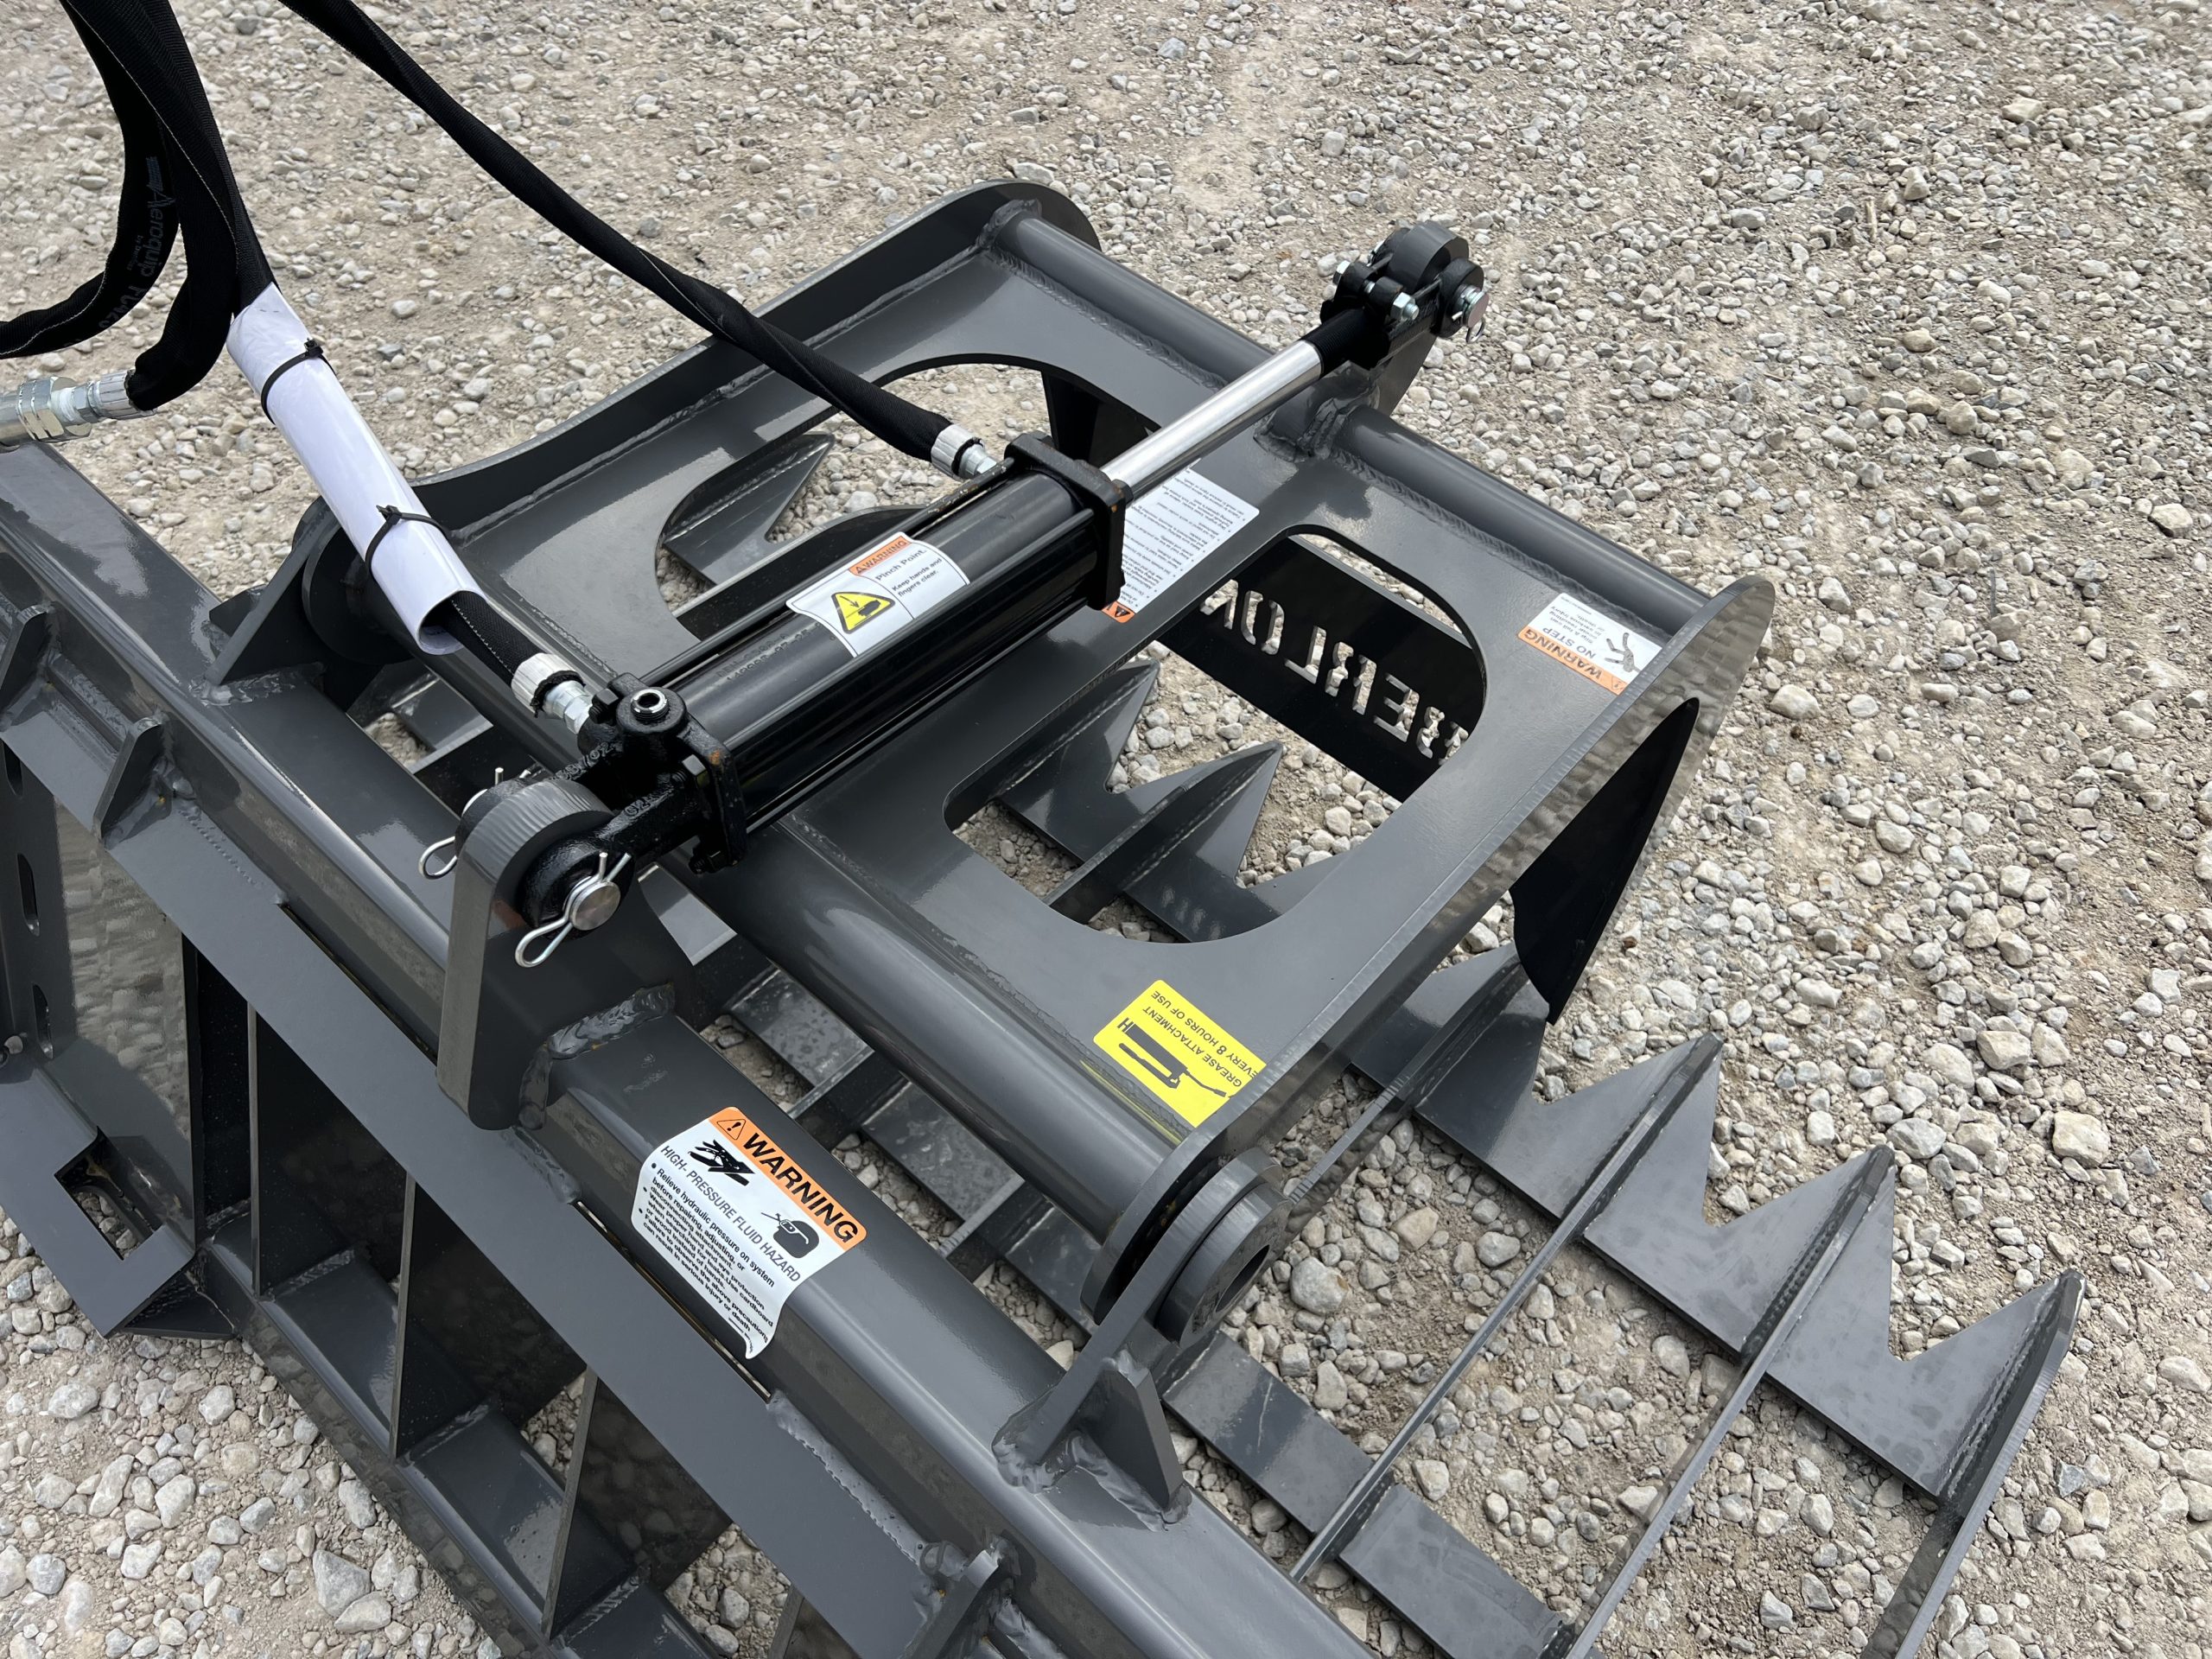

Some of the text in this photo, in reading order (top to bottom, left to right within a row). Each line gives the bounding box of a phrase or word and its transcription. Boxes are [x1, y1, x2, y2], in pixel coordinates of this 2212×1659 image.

[141, 189, 175, 277] Aeroquip
[864, 541, 908, 569] WARNING
[874, 563, 902, 582] Pinch
[891, 557, 942, 591] Keep hands and
[897, 579, 922, 597] fingers
[1525, 629, 1602, 679] WARNING
[1542, 627, 1597, 659] NO STEP
[1141, 1004, 1243, 1088] GREASE ATTACHMENT
[1151, 990, 1258, 1078] EVERY 8 HOURS OF USE
[649, 1185, 696, 1231] disconnecting
[651, 1177, 674, 1200] before
[671, 1198, 705, 1232] repairing,
[736, 1262, 746, 1272] or
[656, 1167, 776, 1287] Relieve hydraulic pressure on system
[660, 1146, 801, 1283] HIGH- PRESSURE FLUID HAZARD
[743, 1133, 859, 1243] WARNING
[642, 1222, 655, 1235] can
[654, 1234, 674, 1253] result
[673, 1252, 681, 1261] in
[679, 1259, 705, 1285] serious
[702, 1282, 724, 1305] injury
[722, 1302, 731, 1312] or
[643, 1213, 667, 1237] Failure
[665, 1236, 674, 1245] to
[673, 1243, 700, 1271] observe
[699, 1269, 710, 1281] the
[710, 1281, 733, 1303] above
[645, 1207, 653, 1217] or
[652, 1215, 672, 1235] wood
[671, 1233, 696, 1259] instead
[695, 1257, 703, 1266] of
[646, 1199, 665, 1219] when
[664, 1217, 697, 1251] searching
[696, 1249, 707, 1260] for
[738, 1291, 774, 1326] cardboard
[647, 1192, 766, 1310] Wear proper hand and eye protection
